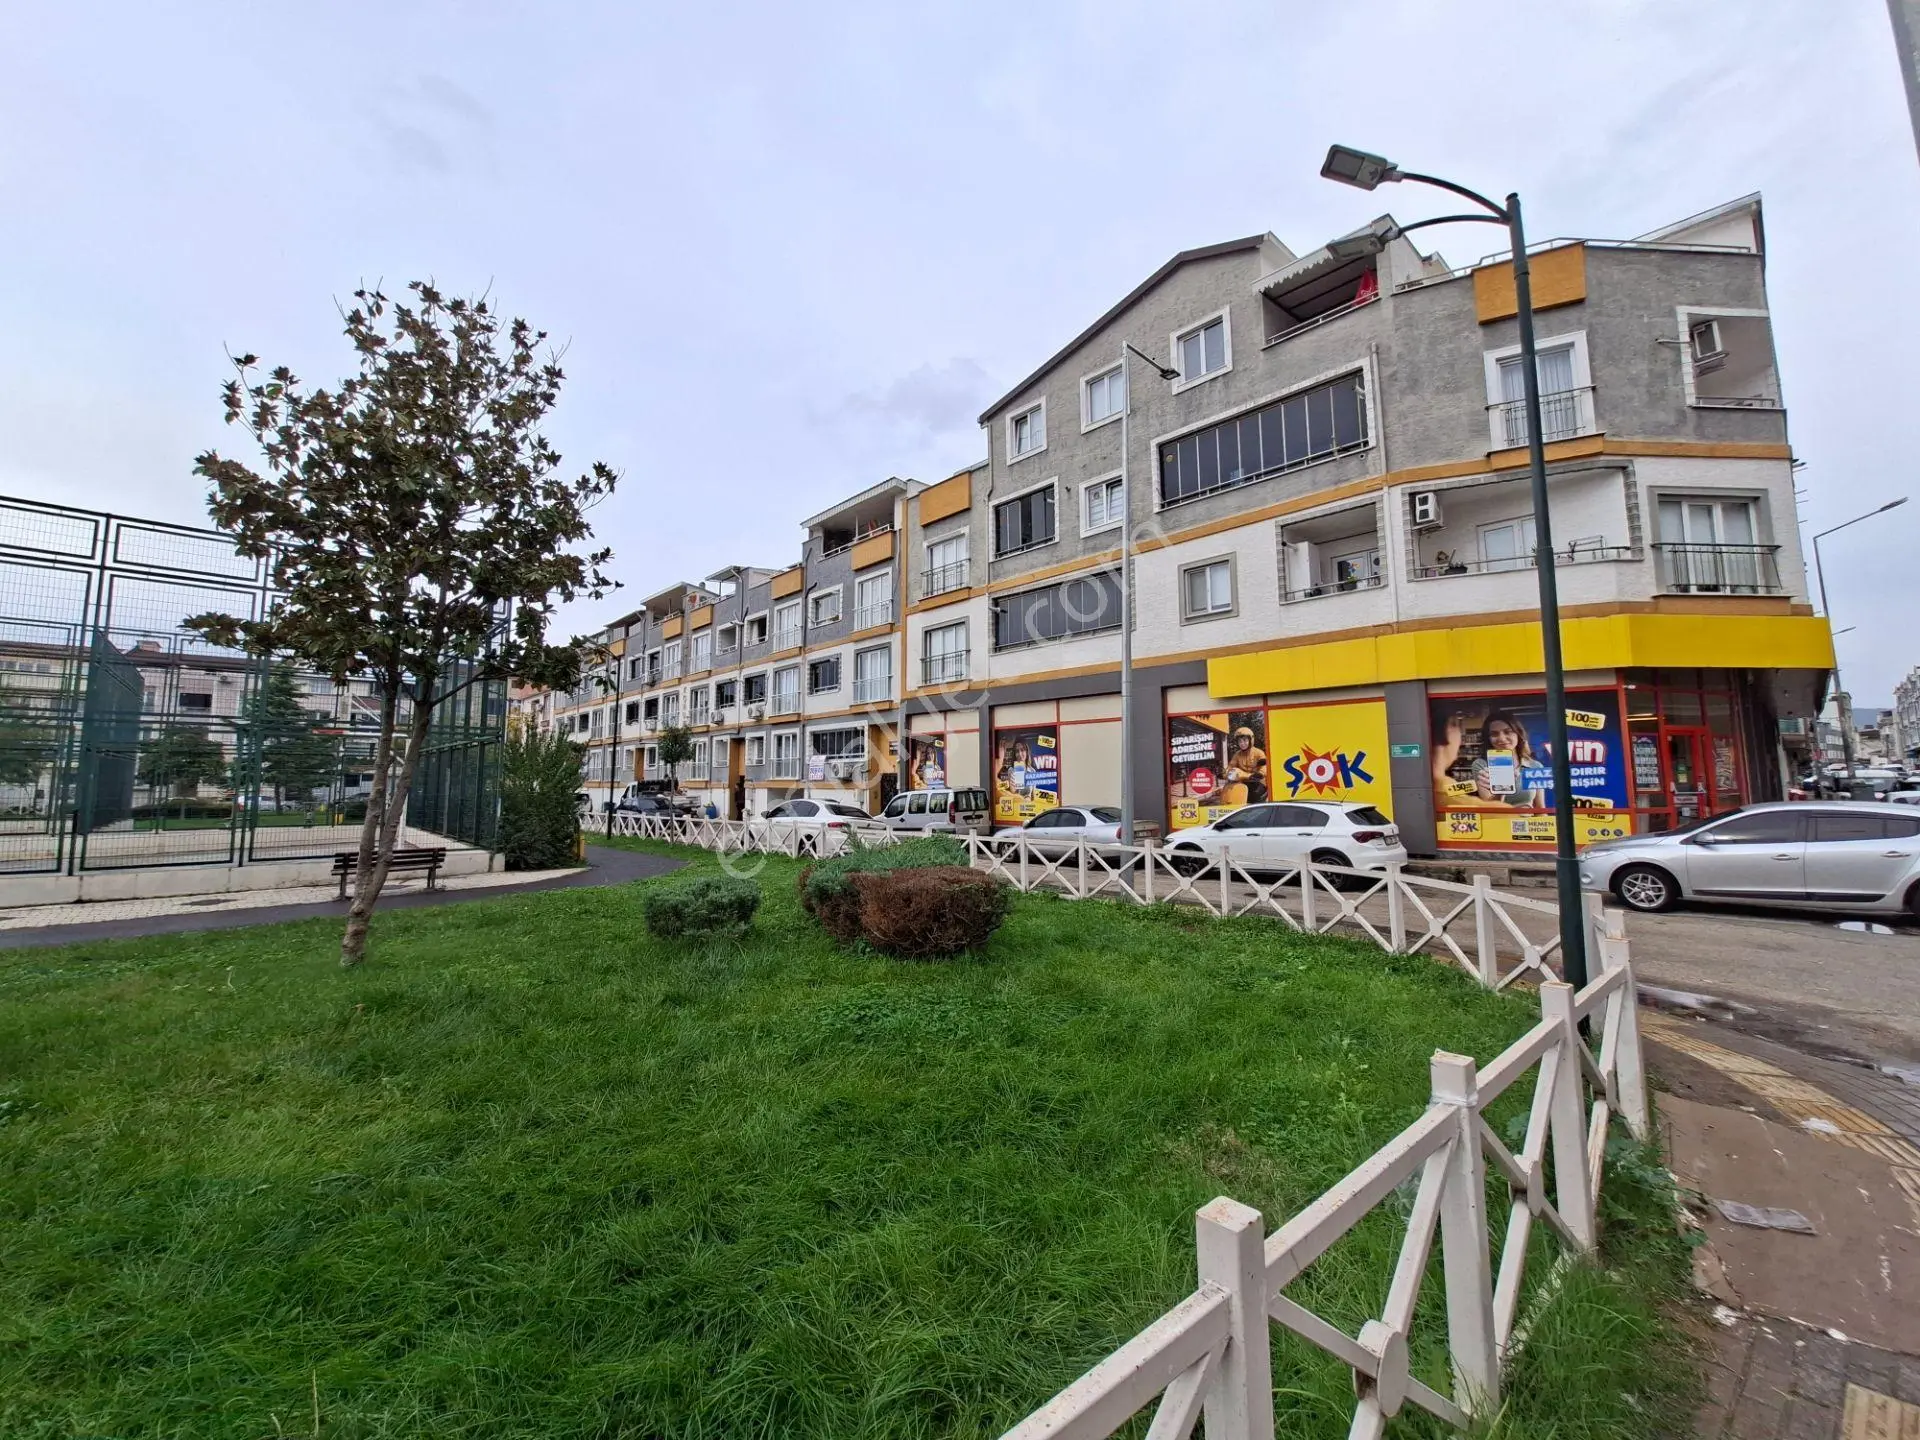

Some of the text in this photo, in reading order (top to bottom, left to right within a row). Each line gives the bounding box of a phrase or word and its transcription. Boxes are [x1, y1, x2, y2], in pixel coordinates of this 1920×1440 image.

[1171, 742, 1213, 755] ADRESİNE
[1171, 752, 1215, 763] GETİRELİM
[1283, 750, 1375, 798] ŞOK
[1525, 767, 1607, 778] KAZDIRIR
[1528, 778, 1606, 789] ALIŞRİŞİN
